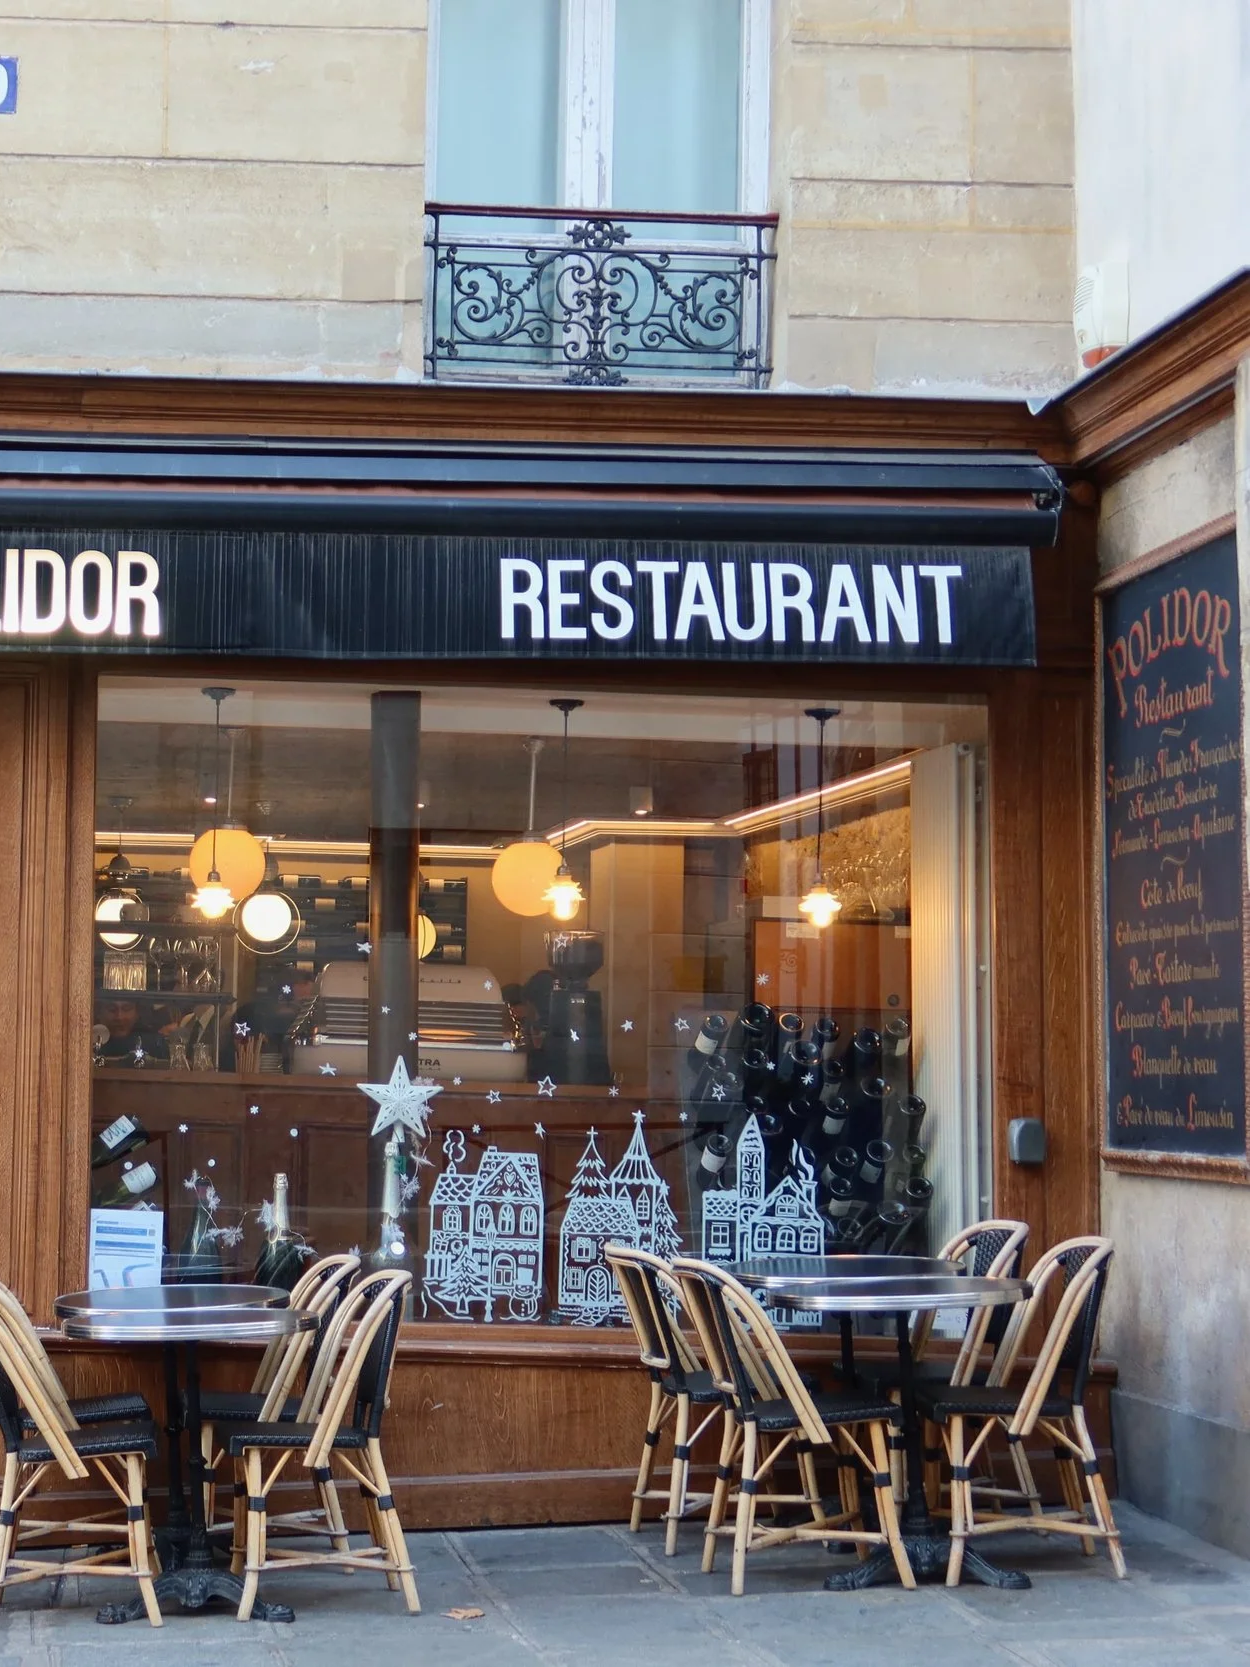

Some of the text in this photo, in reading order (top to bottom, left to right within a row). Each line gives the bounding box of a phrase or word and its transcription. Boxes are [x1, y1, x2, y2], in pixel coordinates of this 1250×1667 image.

[499, 558, 963, 644] RESTAURANT
[1107, 586, 1232, 719] POLIDOR
[1134, 666, 1215, 728] Restaurant
